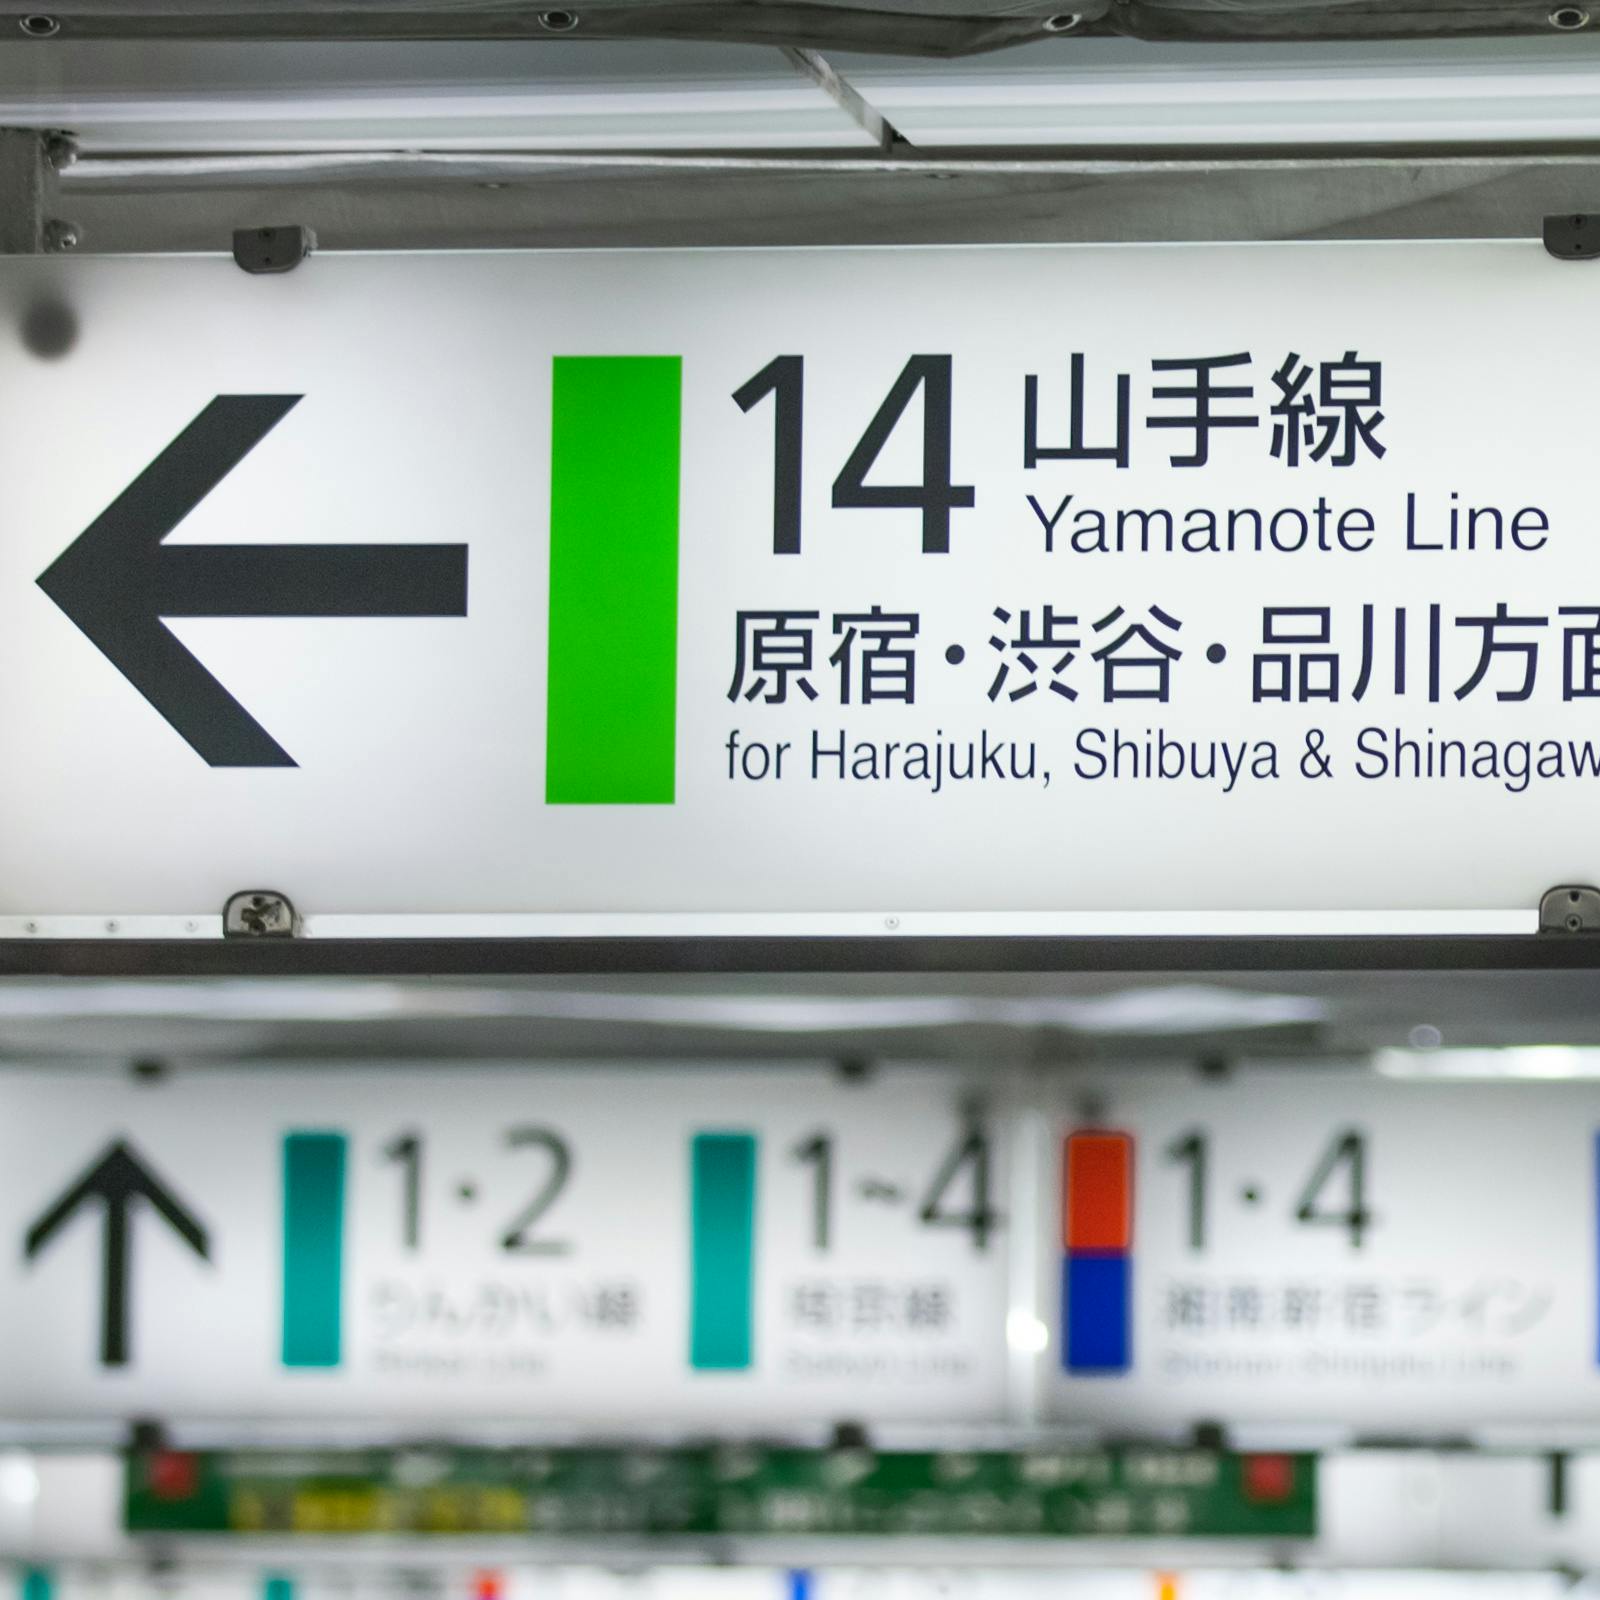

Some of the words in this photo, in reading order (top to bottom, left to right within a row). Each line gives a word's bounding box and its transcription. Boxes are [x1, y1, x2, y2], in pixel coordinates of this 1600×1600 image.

[731, 353, 976, 555] 14
[1023, 350, 1387, 469] 山手線
[1025, 494, 1375, 554] Yamanote
[1406, 492, 1549, 552] Line
[725, 729, 791, 781] for
[811, 729, 1050, 794] Harajuku,
[1074, 727, 1280, 793] Shibuya
[1299, 728, 1333, 779] &
